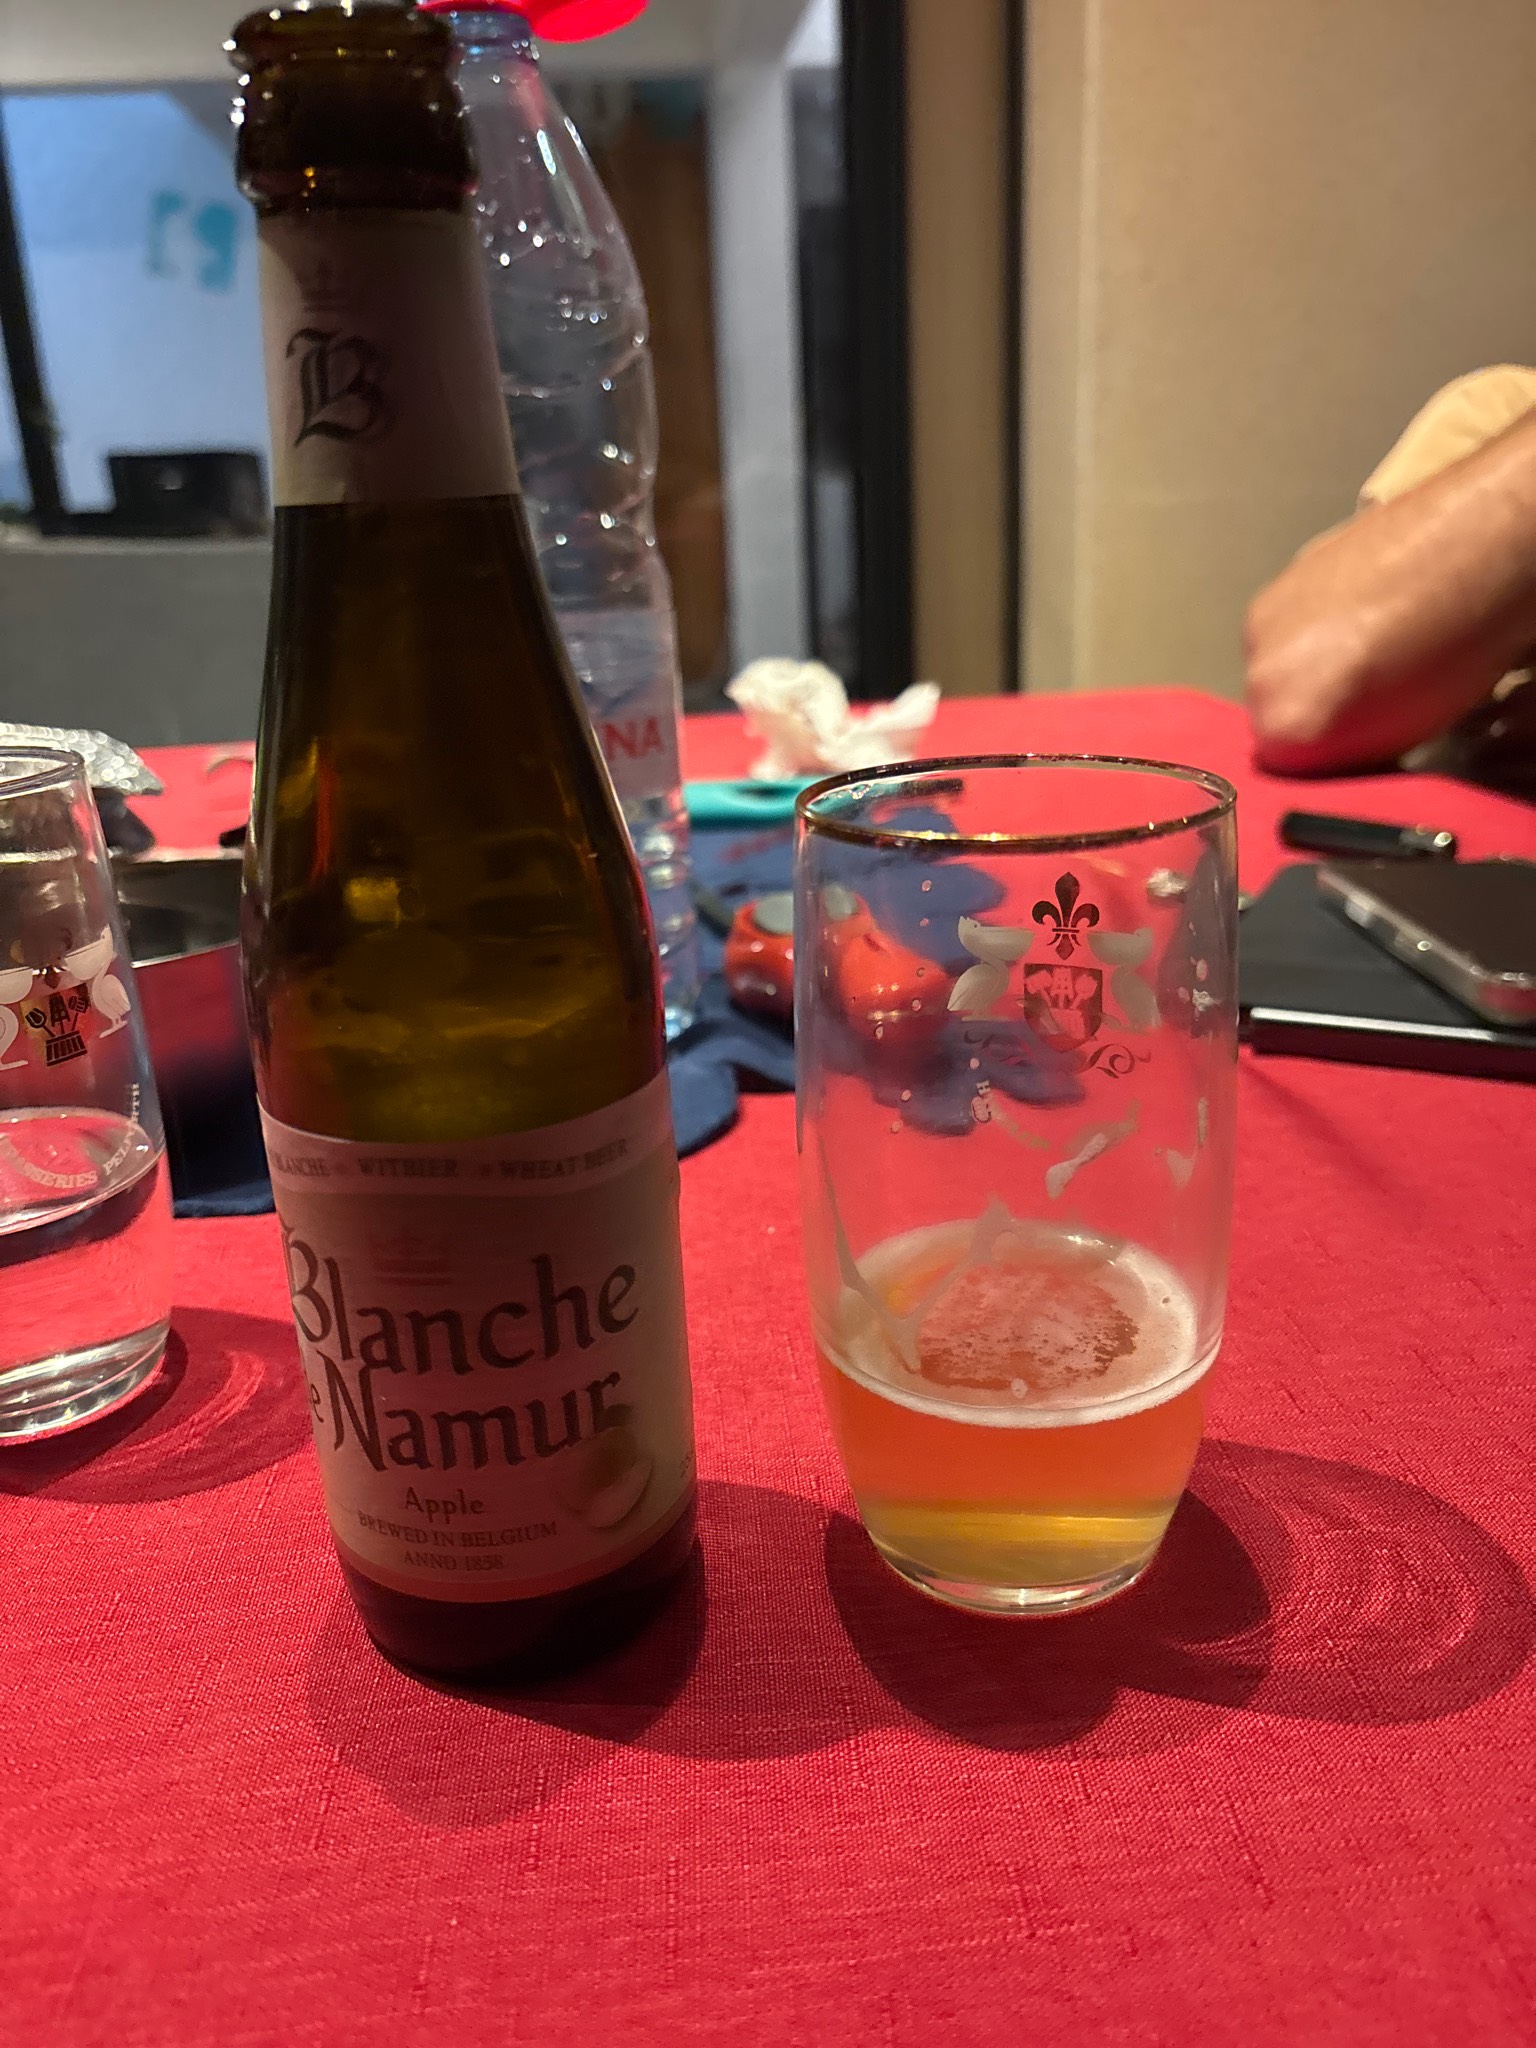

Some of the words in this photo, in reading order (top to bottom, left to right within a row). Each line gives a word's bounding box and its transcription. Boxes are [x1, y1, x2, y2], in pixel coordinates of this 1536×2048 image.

[358, 1156, 459, 1179] WITBIER
[500, 1156, 577, 1180] WHEAT
[584, 1138, 629, 1172] BEER
[282, 1222, 640, 1376] Blanche
[316, 1349, 622, 1473] Namur
[404, 1486, 485, 1525] Apple
[358, 1510, 428, 1547] BREWED
[432, 1528, 456, 1548] IN
[459, 1521, 559, 1548] BELGIUM
[403, 1549, 457, 1571] ANNO
